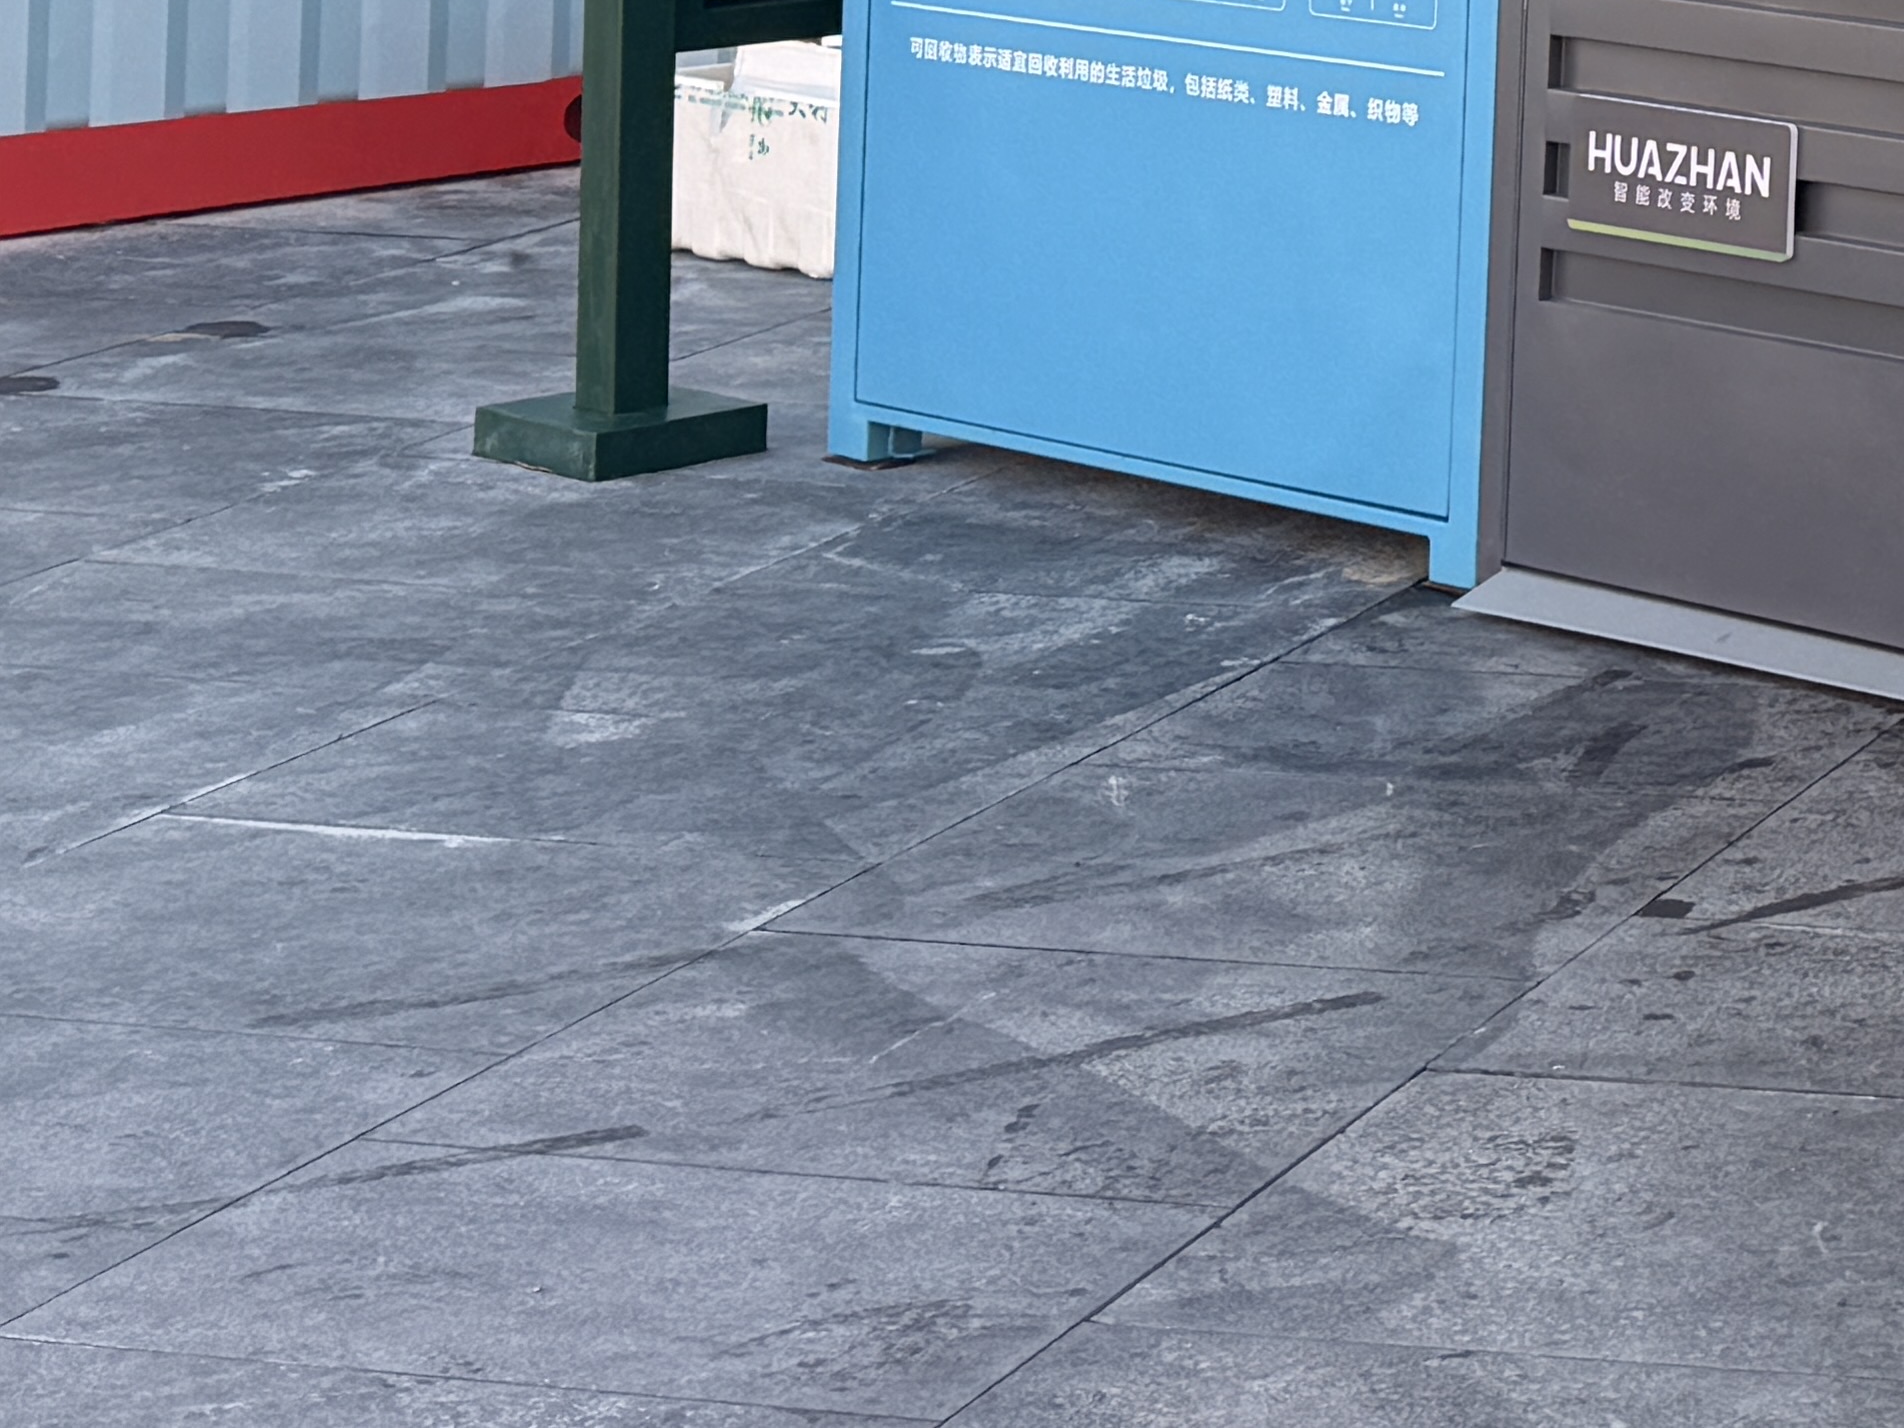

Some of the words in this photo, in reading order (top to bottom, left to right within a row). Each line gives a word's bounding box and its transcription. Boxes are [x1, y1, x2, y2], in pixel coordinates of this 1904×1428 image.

[1587, 130, 1771, 198] HUAZHAN
[1613, 181, 1741, 221] 智能改变环境
